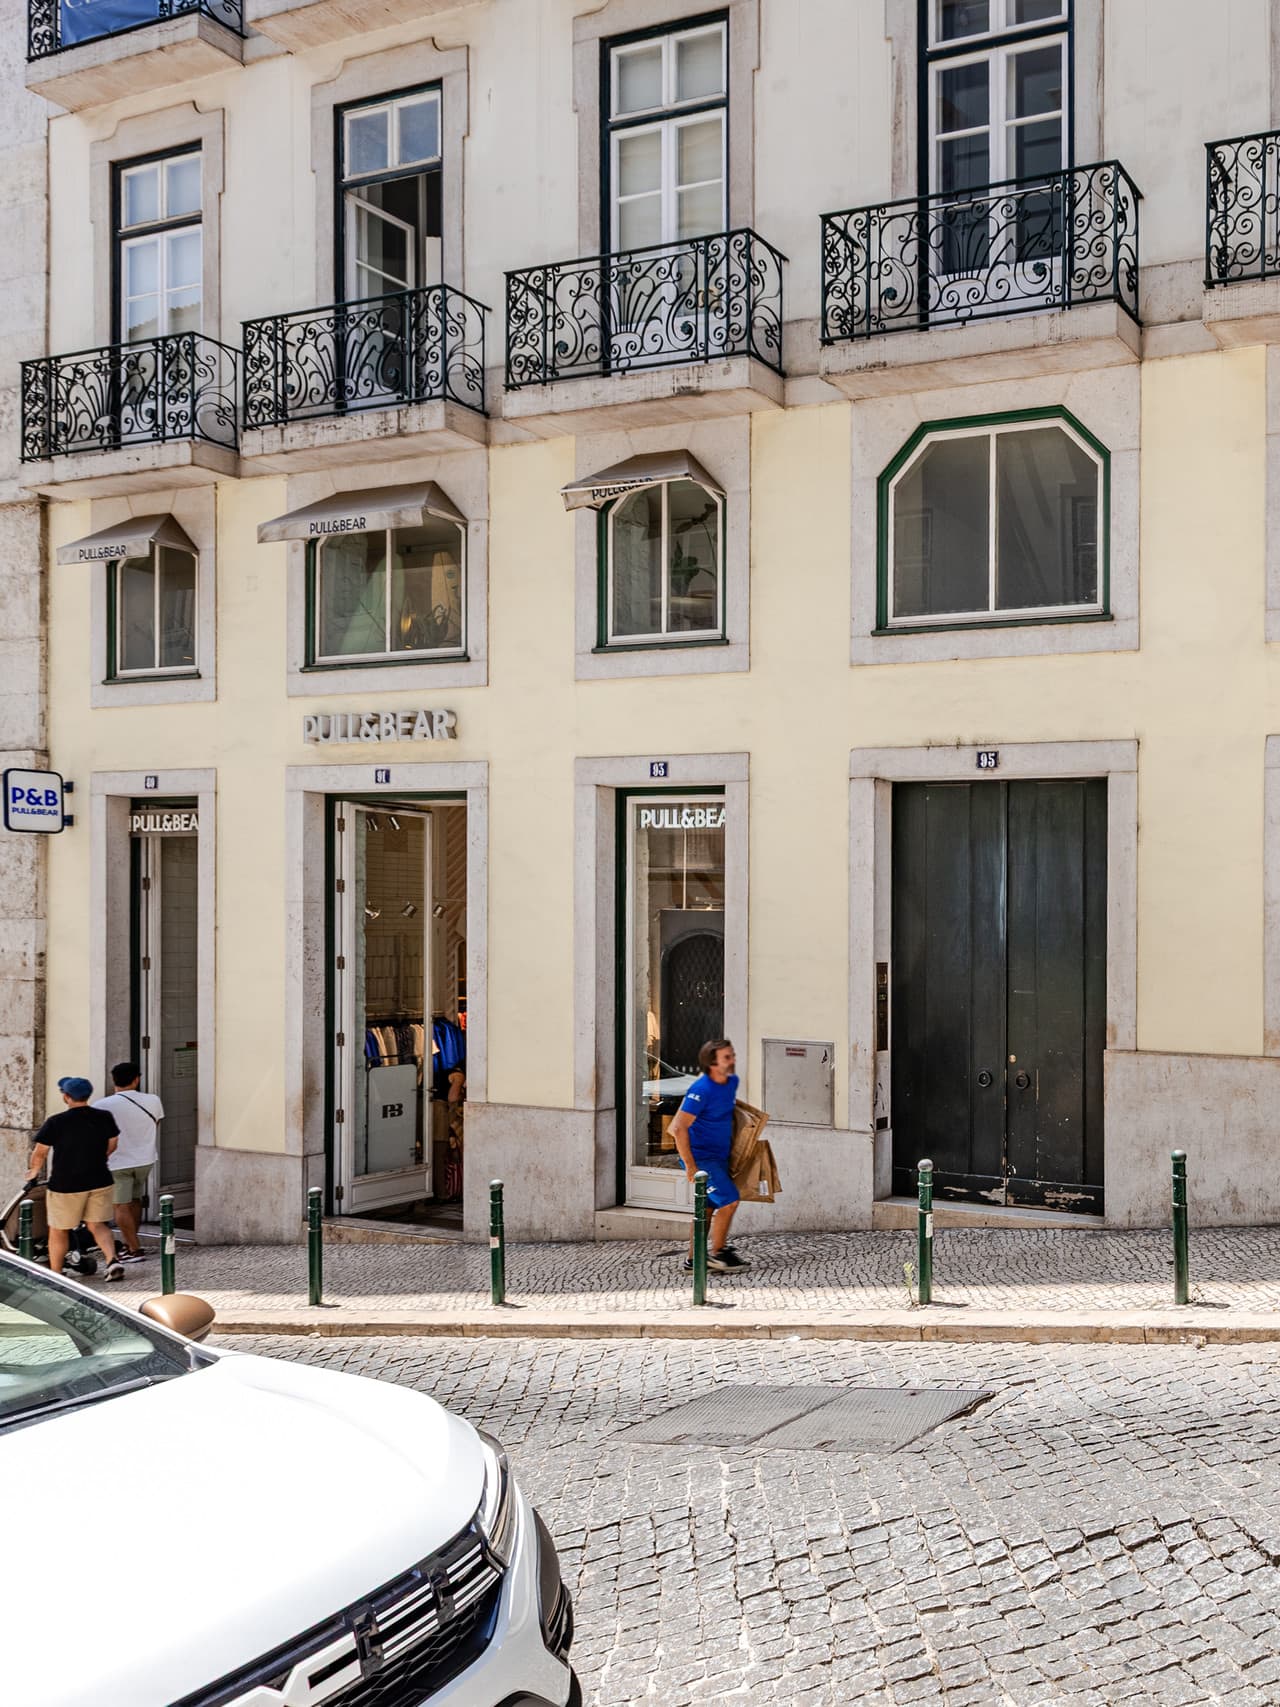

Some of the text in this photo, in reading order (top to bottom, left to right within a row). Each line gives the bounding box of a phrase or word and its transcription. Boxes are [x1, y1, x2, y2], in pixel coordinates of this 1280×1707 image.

[591, 477, 654, 500] PULL&BE
[309, 516, 367, 534] PULL&BEAR
[79, 544, 127, 560] PULL&BEAR
[302, 709, 457, 745] PULL&BEAR
[980, 752, 996, 768] 95
[652, 762, 665, 777] 93
[11, 786, 58, 806] P&B
